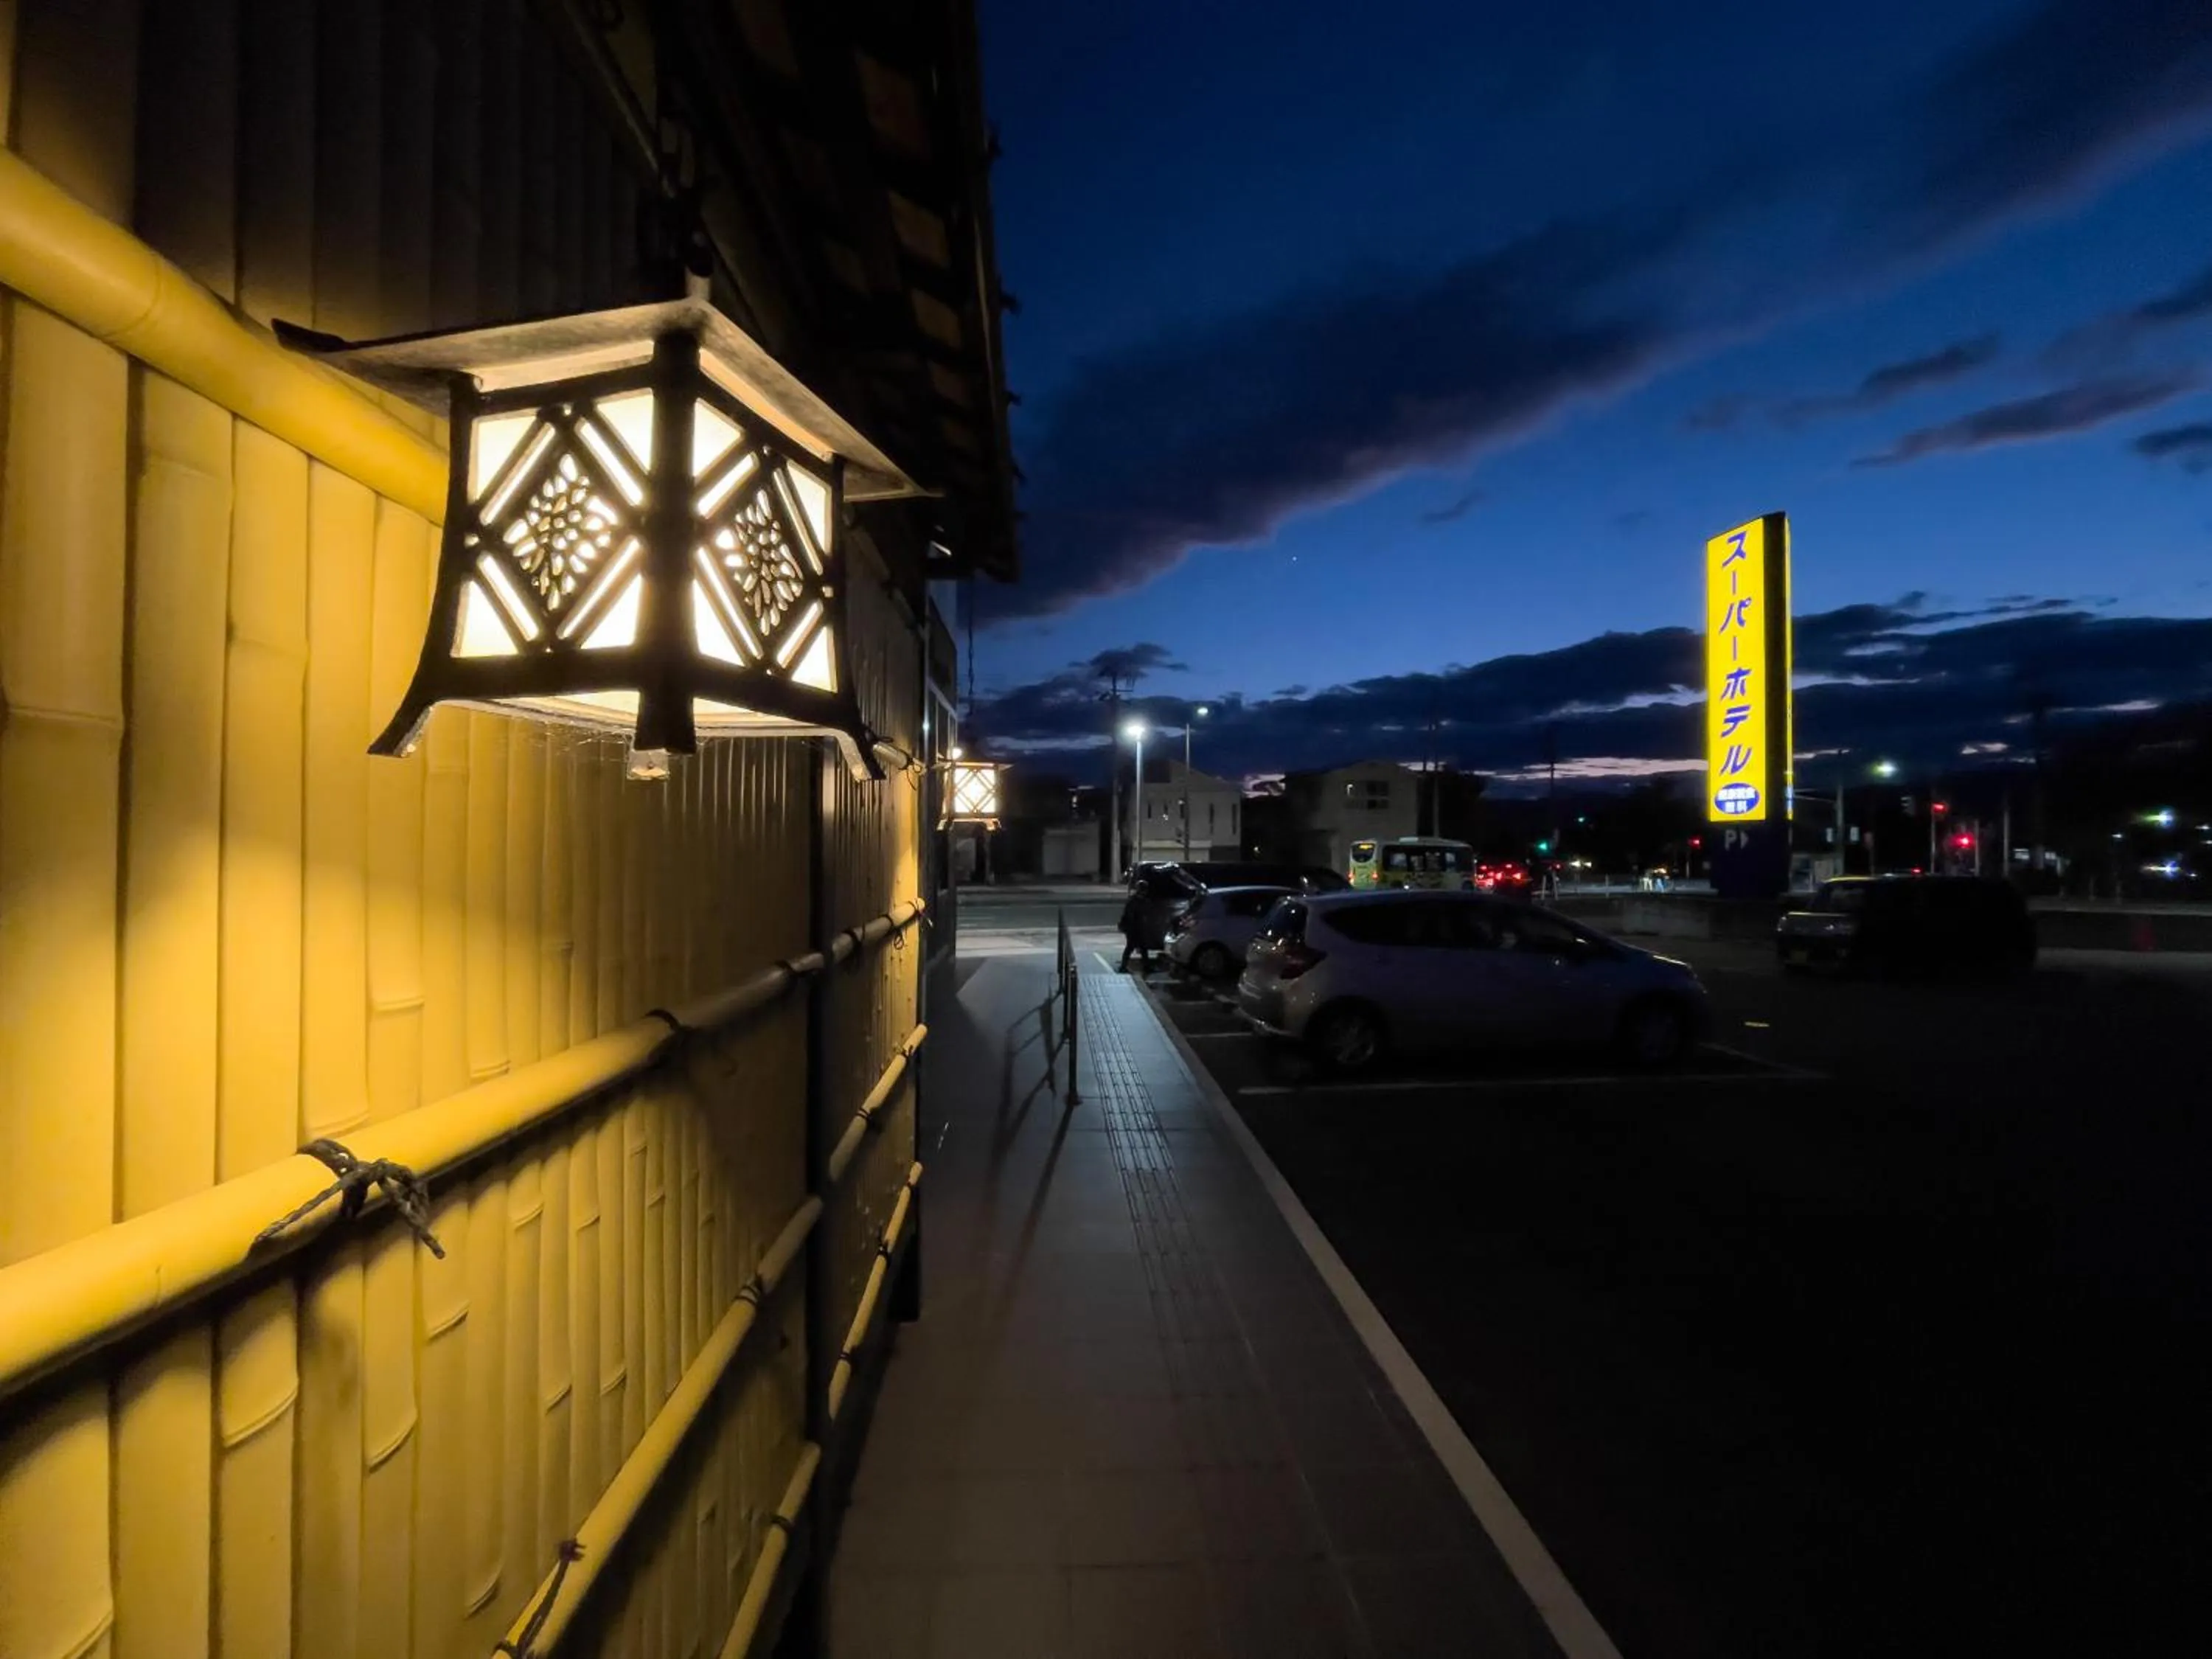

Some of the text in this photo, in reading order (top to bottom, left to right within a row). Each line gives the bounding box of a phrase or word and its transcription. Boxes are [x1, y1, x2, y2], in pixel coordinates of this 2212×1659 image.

[1719, 530, 1753, 775] スーパーホテル
[1725, 830, 1737, 850] P
